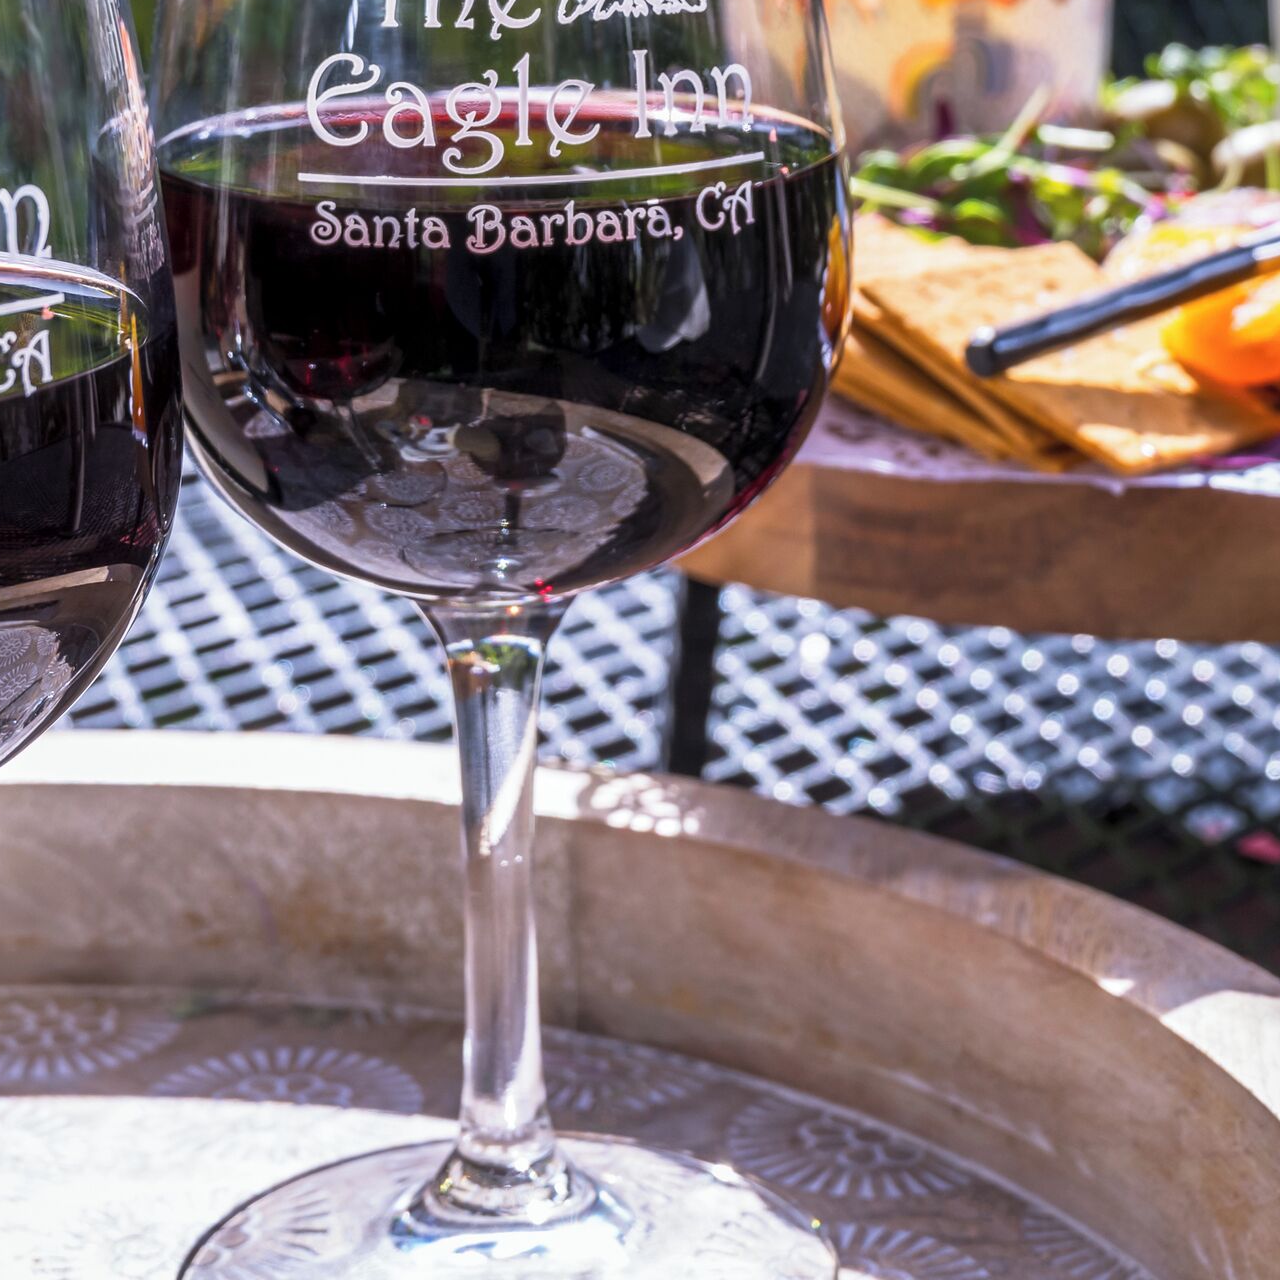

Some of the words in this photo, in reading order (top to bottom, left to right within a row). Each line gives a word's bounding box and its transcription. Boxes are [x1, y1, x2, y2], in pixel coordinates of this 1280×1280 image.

[306, 52, 601, 175] Eagle
[631, 49, 755, 139] Inn
[310, 200, 451, 249] Santa
[466, 198, 684, 255] Barbara,
[695, 179, 756, 237] CA
